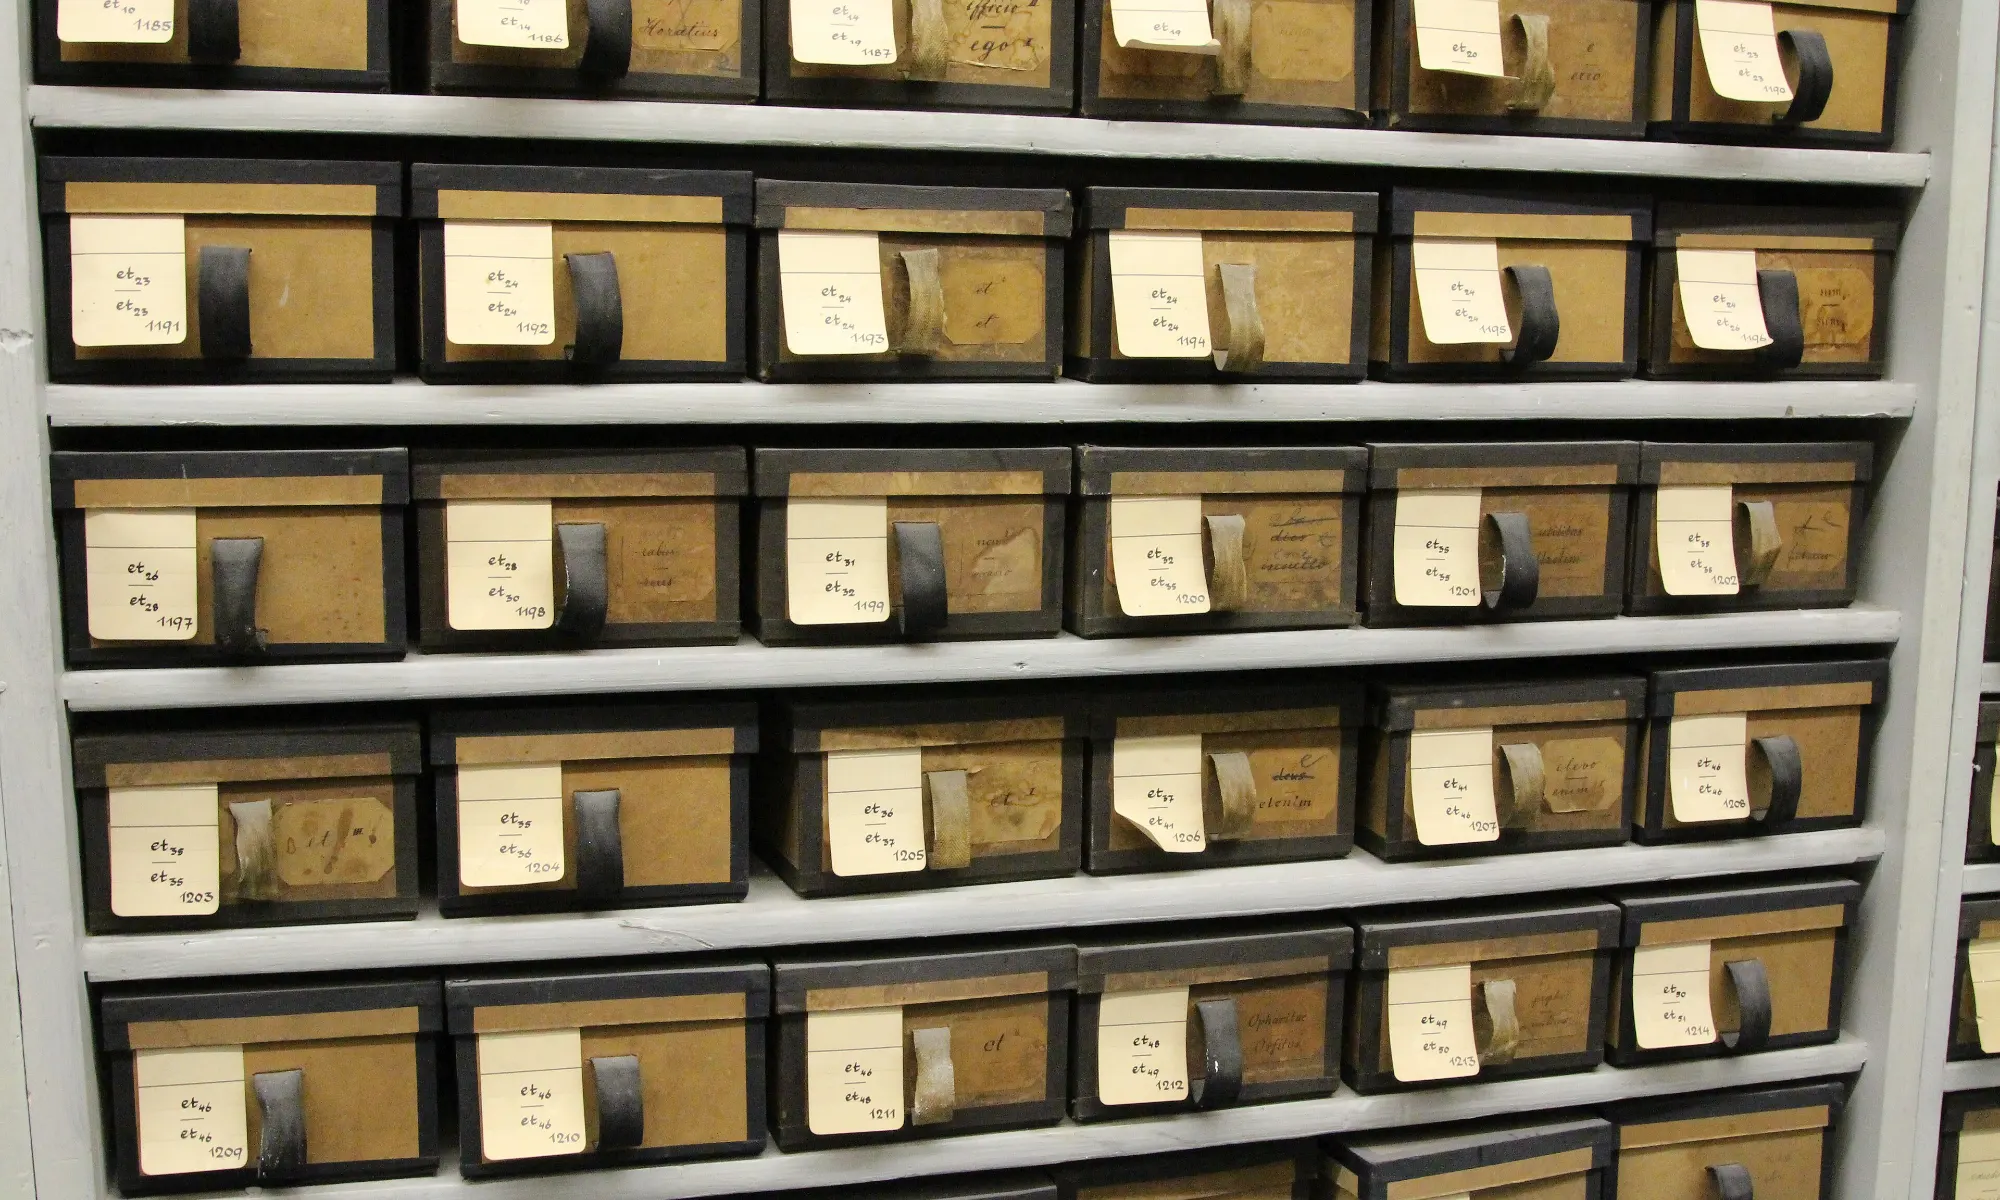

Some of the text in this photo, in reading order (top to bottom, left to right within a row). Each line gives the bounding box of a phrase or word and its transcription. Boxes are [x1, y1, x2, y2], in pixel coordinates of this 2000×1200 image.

[134, 19, 173, 31] 1185
[528, 33, 564, 43] 1186
[861, 48, 893, 58] 1187
[1763, 85, 1786, 95] 1190
[145, 319, 180, 335] 1191
[516, 321, 550, 335] 1192
[1479, 324, 1507, 337] 1195
[850, 332, 885, 346] 1193
[1176, 335, 1206, 350] 1194
[1742, 333, 1768, 344] 1196
[1710, 574, 1738, 586] 1202
[1448, 585, 1476, 597] 1201
[1175, 593, 1206, 605] 1200
[515, 605, 546, 621] 1198
[853, 600, 885, 614] 1199
[156, 615, 194, 632] 1197
[1722, 798, 1747, 809] 1208
[1468, 820, 1498, 834] 1207
[1172, 829, 1201, 843] 1206
[892, 849, 925, 862] 1205
[524, 861, 561, 873] 1204
[179, 890, 215, 904] 1203
[1684, 1025, 1710, 1036] 1214
[1449, 1055, 1476, 1068] 1213
[1155, 1079, 1185, 1091] 1212
[868, 1107, 896, 1120] 1211
[548, 1132, 581, 1144] 1210
[208, 1146, 244, 1161] 1209
